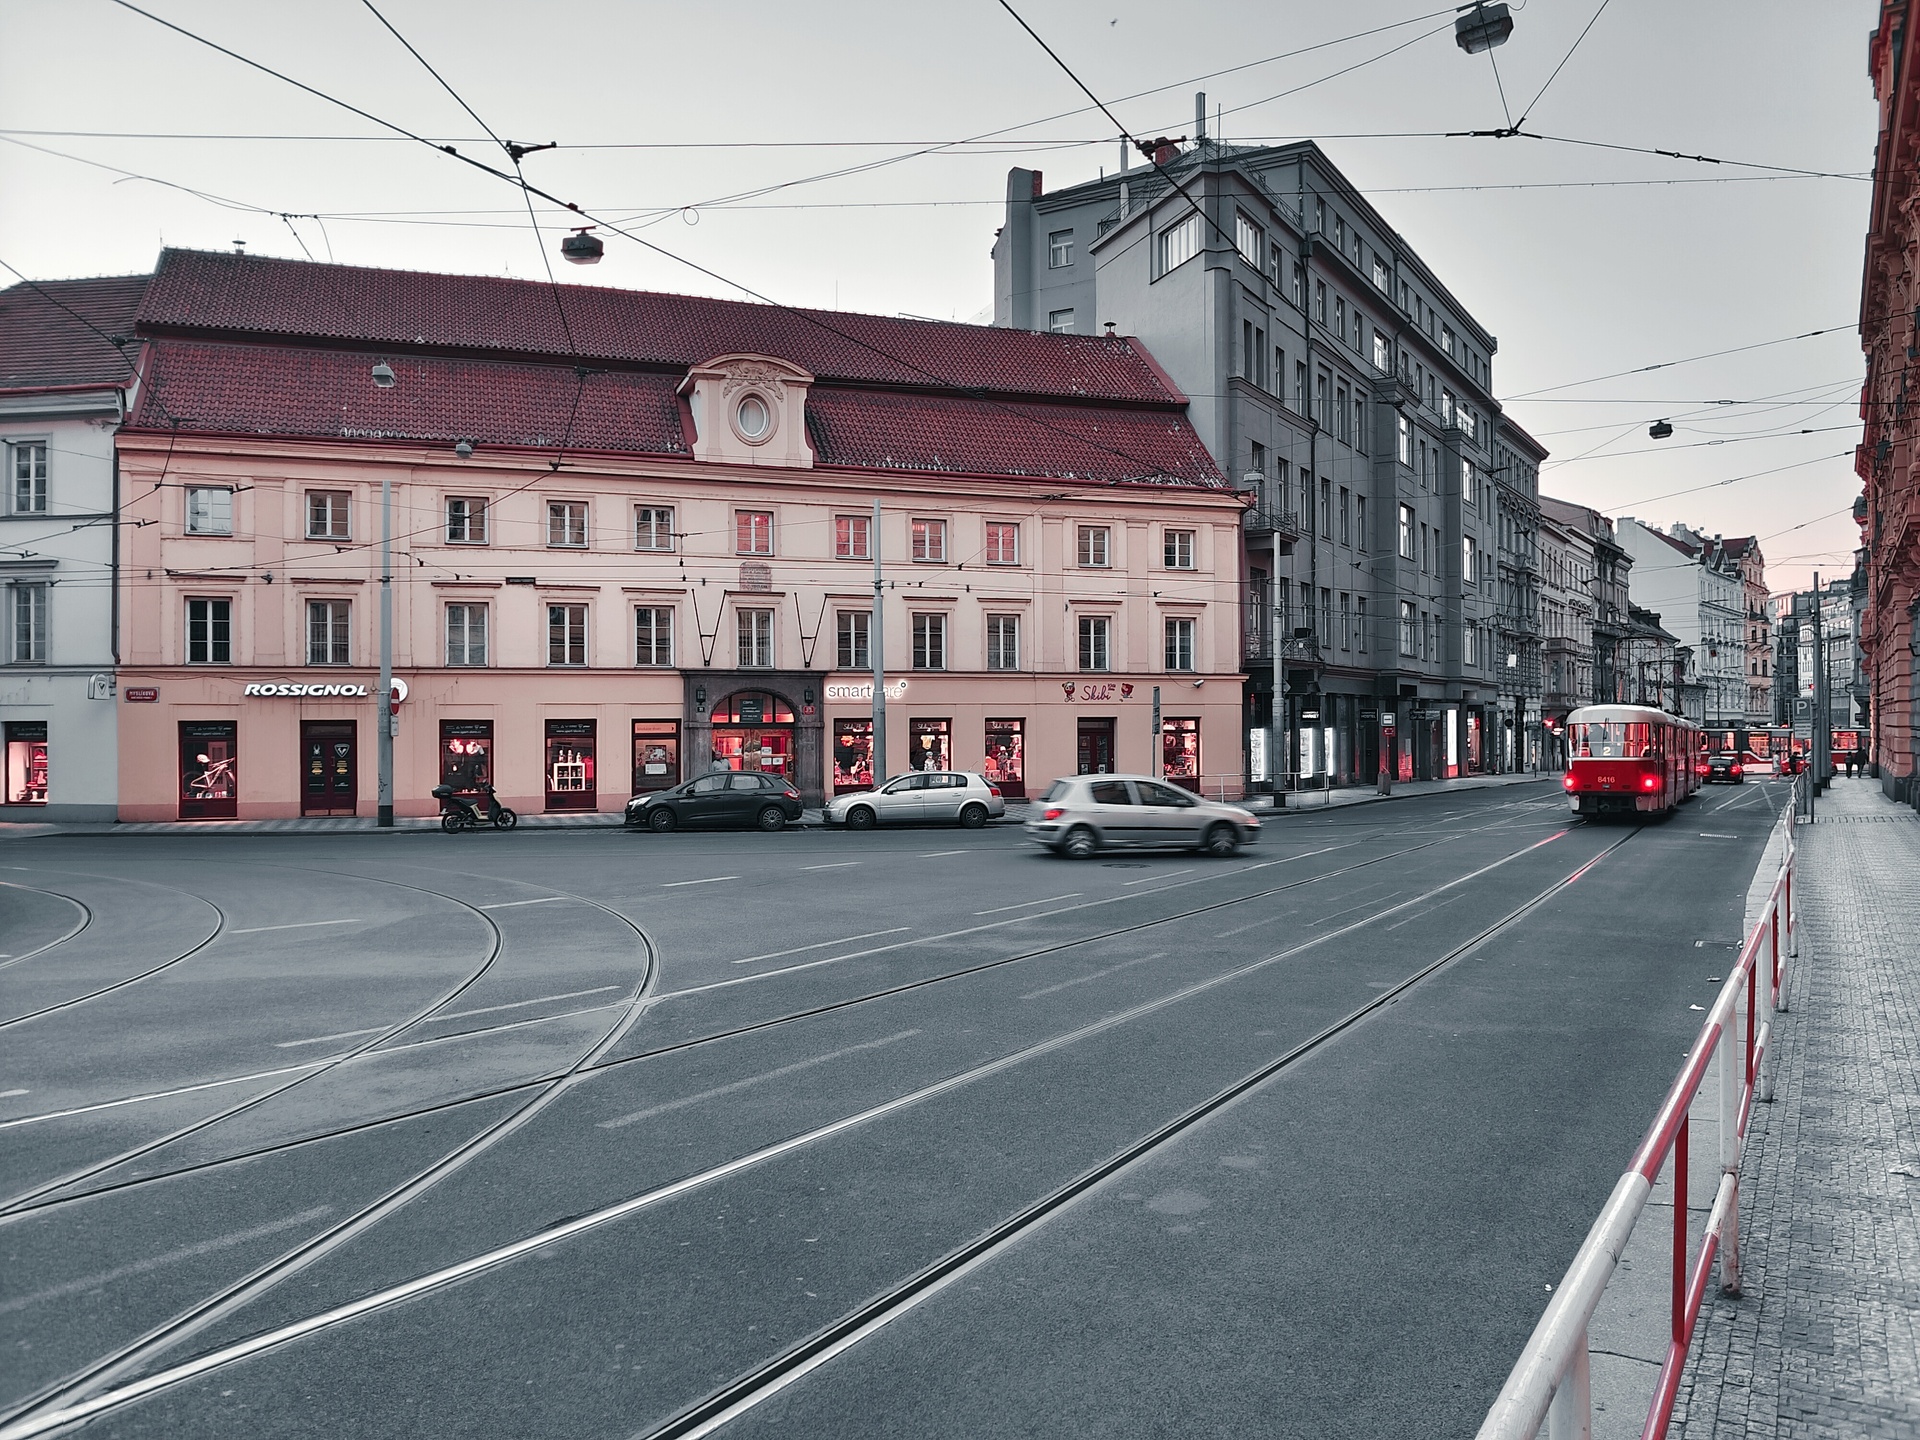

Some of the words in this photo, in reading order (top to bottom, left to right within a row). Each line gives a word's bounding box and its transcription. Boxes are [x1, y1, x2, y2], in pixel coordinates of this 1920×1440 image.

[244, 683, 368, 697] ROSSIGNOL
[828, 684, 903, 698] smartare
[1080, 684, 1112, 701] Skibi
[1797, 701, 1807, 714] P
[1603, 746, 1611, 756] 2
[1597, 775, 1616, 784] 8416
